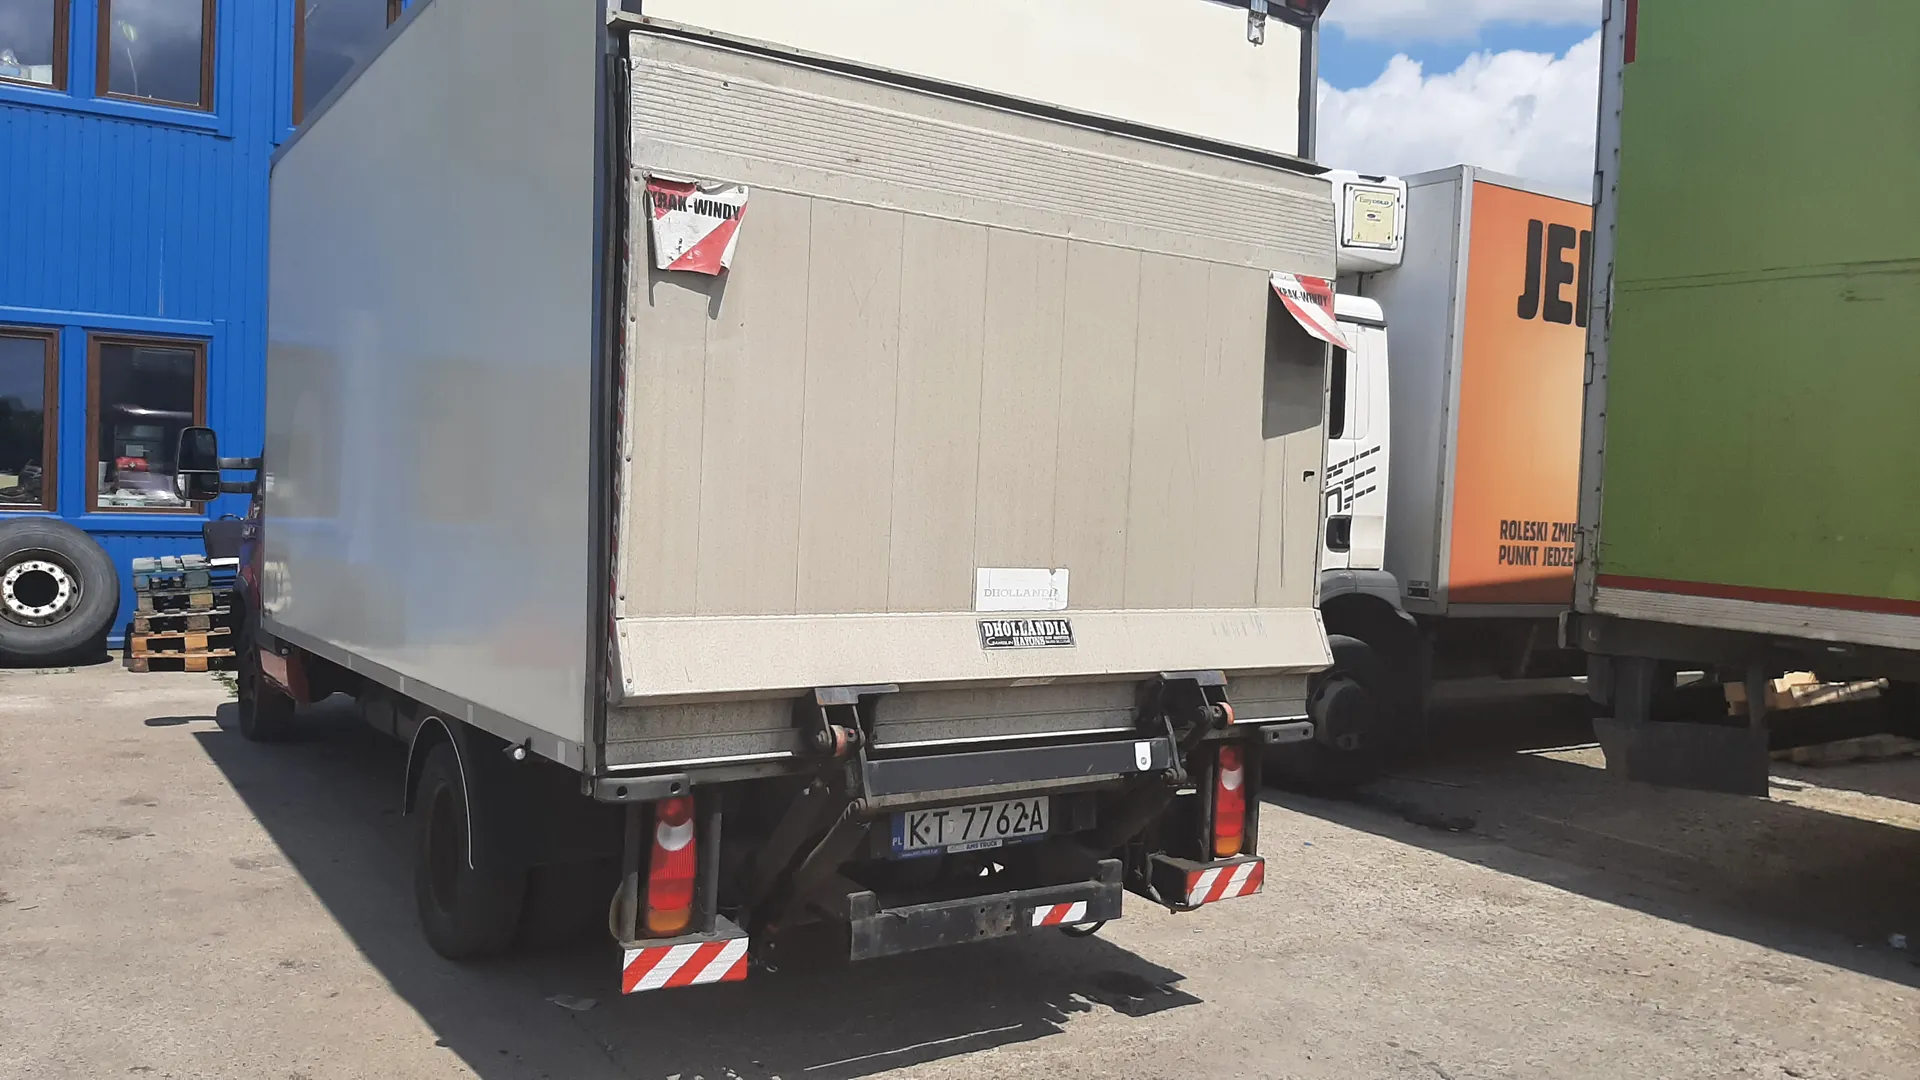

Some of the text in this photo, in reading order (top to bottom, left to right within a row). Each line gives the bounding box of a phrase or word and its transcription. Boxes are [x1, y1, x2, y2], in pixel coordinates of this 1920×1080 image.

[1500, 520, 1548, 541] ROLESKI
[1498, 544, 1575, 567] PUNKT JEDZE
[983, 620, 1069, 637] DHOLLANDIA
[1013, 636, 1046, 646] HAYONS
[892, 800, 1044, 847] PL KT 7762A
